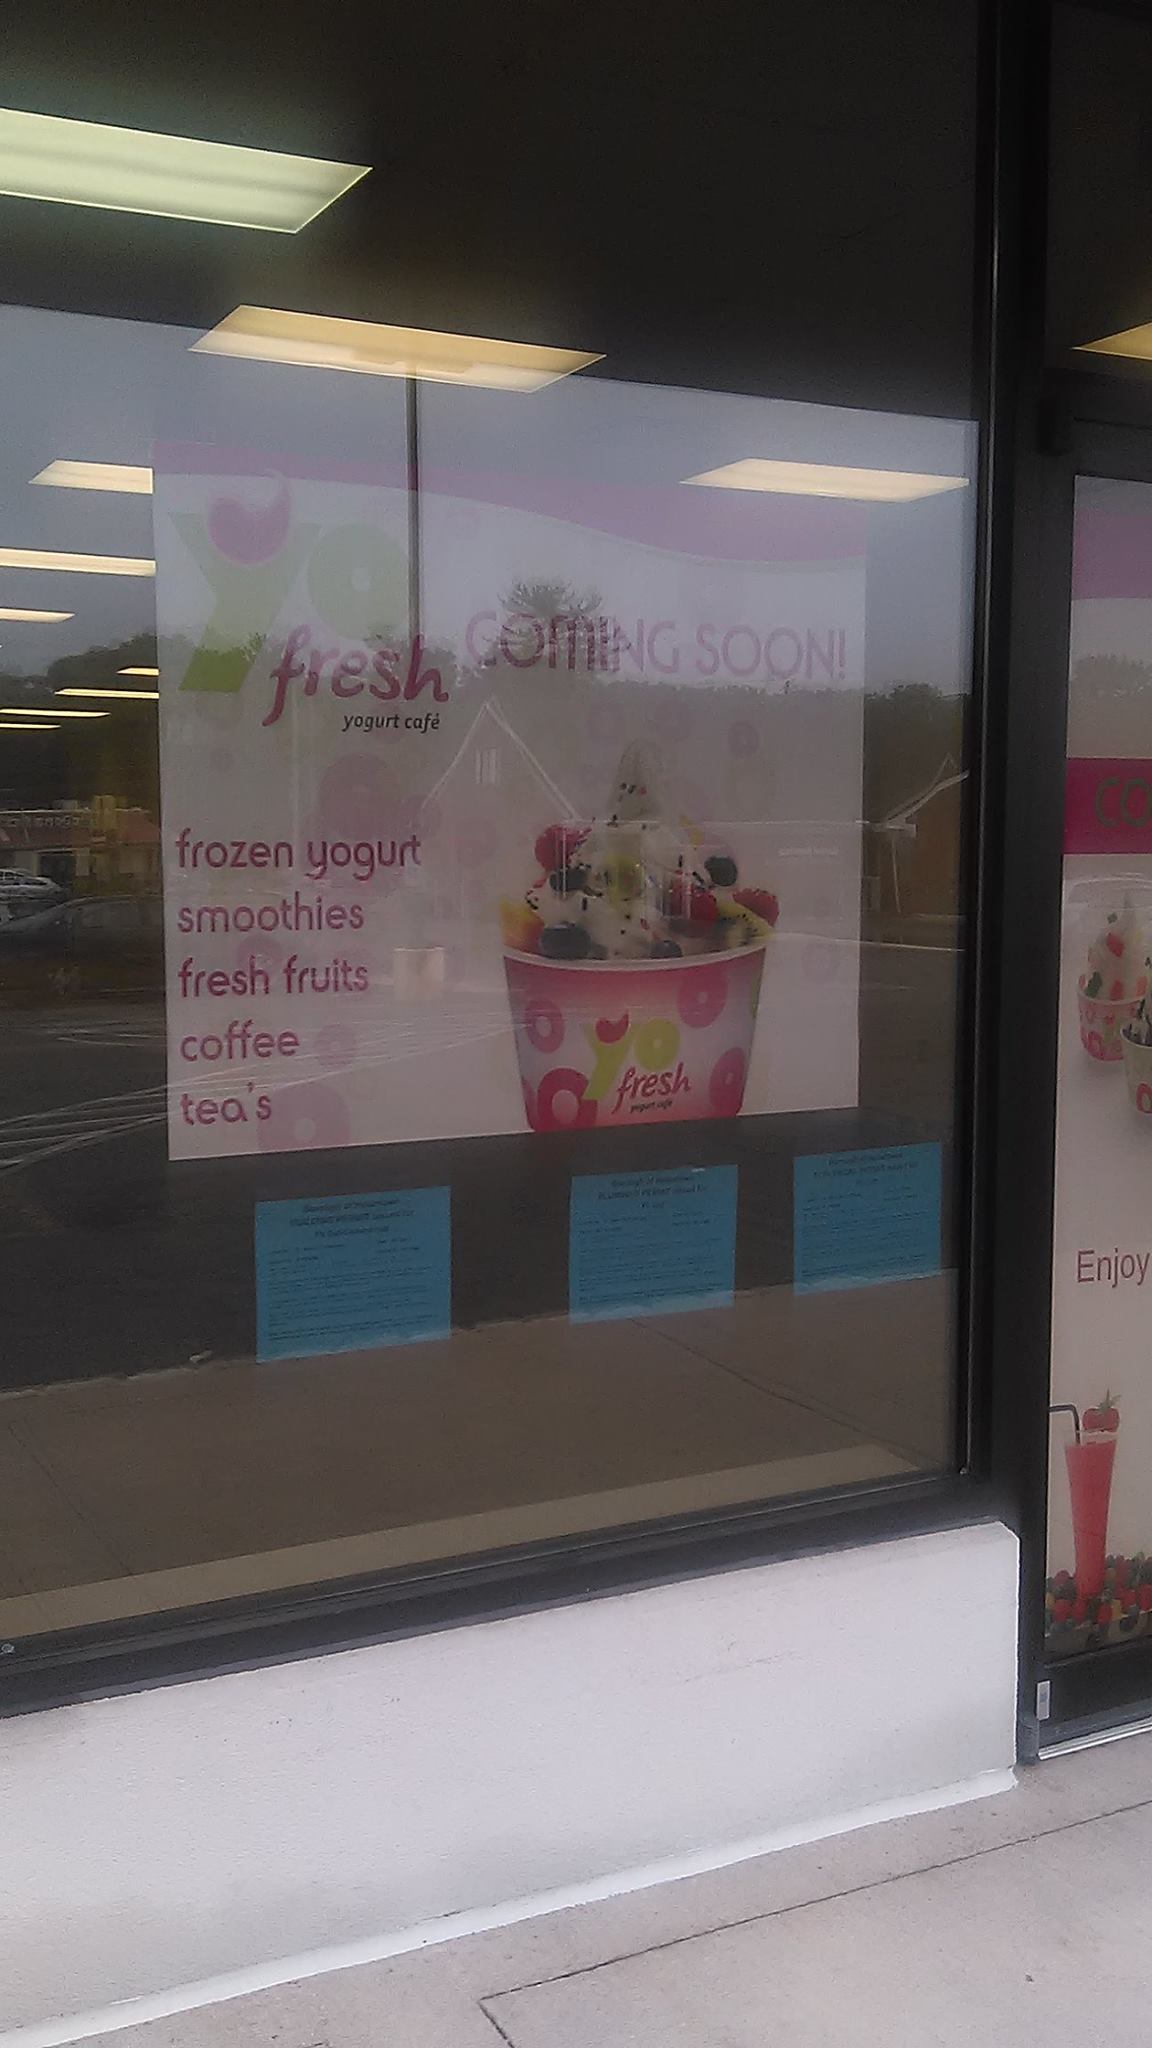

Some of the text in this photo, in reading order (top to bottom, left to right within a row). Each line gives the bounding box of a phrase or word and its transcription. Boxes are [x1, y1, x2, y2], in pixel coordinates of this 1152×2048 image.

[466, 610, 847, 681] COMING SOON!
[262, 624, 449, 727] fresh
[342, 714, 400, 732] yogurt
[175, 828, 422, 881] frozen yogurt
[177, 891, 364, 933] smoothies
[178, 955, 369, 997] fresh fruits
[180, 1019, 300, 1061] coffee
[180, 1082, 272, 1125] tea's
[611, 1062, 692, 1114] fresh
[1077, 1247, 1151, 1288] Enjoy
